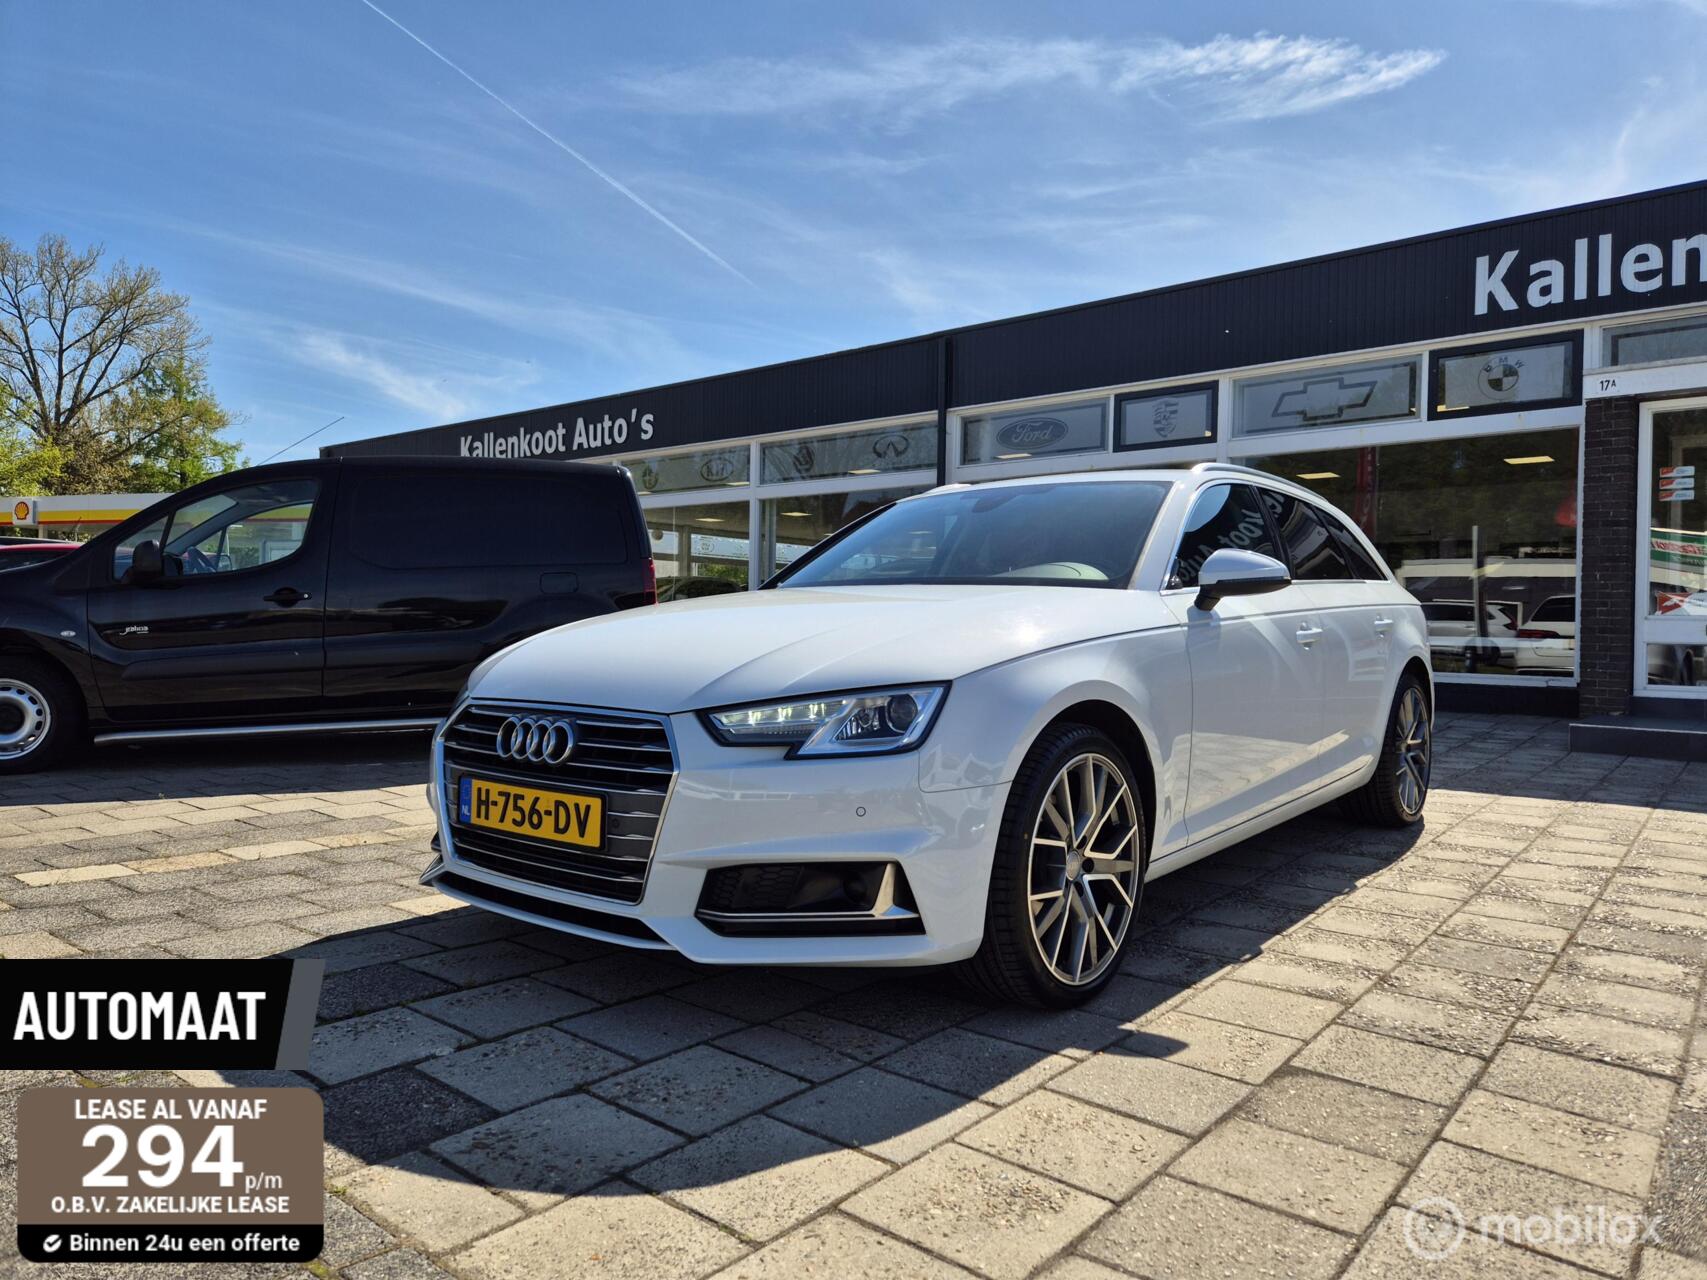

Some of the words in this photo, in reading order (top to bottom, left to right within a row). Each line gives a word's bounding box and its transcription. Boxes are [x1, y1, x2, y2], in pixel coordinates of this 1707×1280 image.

[460, 422, 567, 459] Kallenkoot
[572, 407, 655, 451] Auto's
[1012, 422, 1054, 442] Ford
[461, 805, 471, 816] NL
[475, 786, 592, 838] H-756-DV
